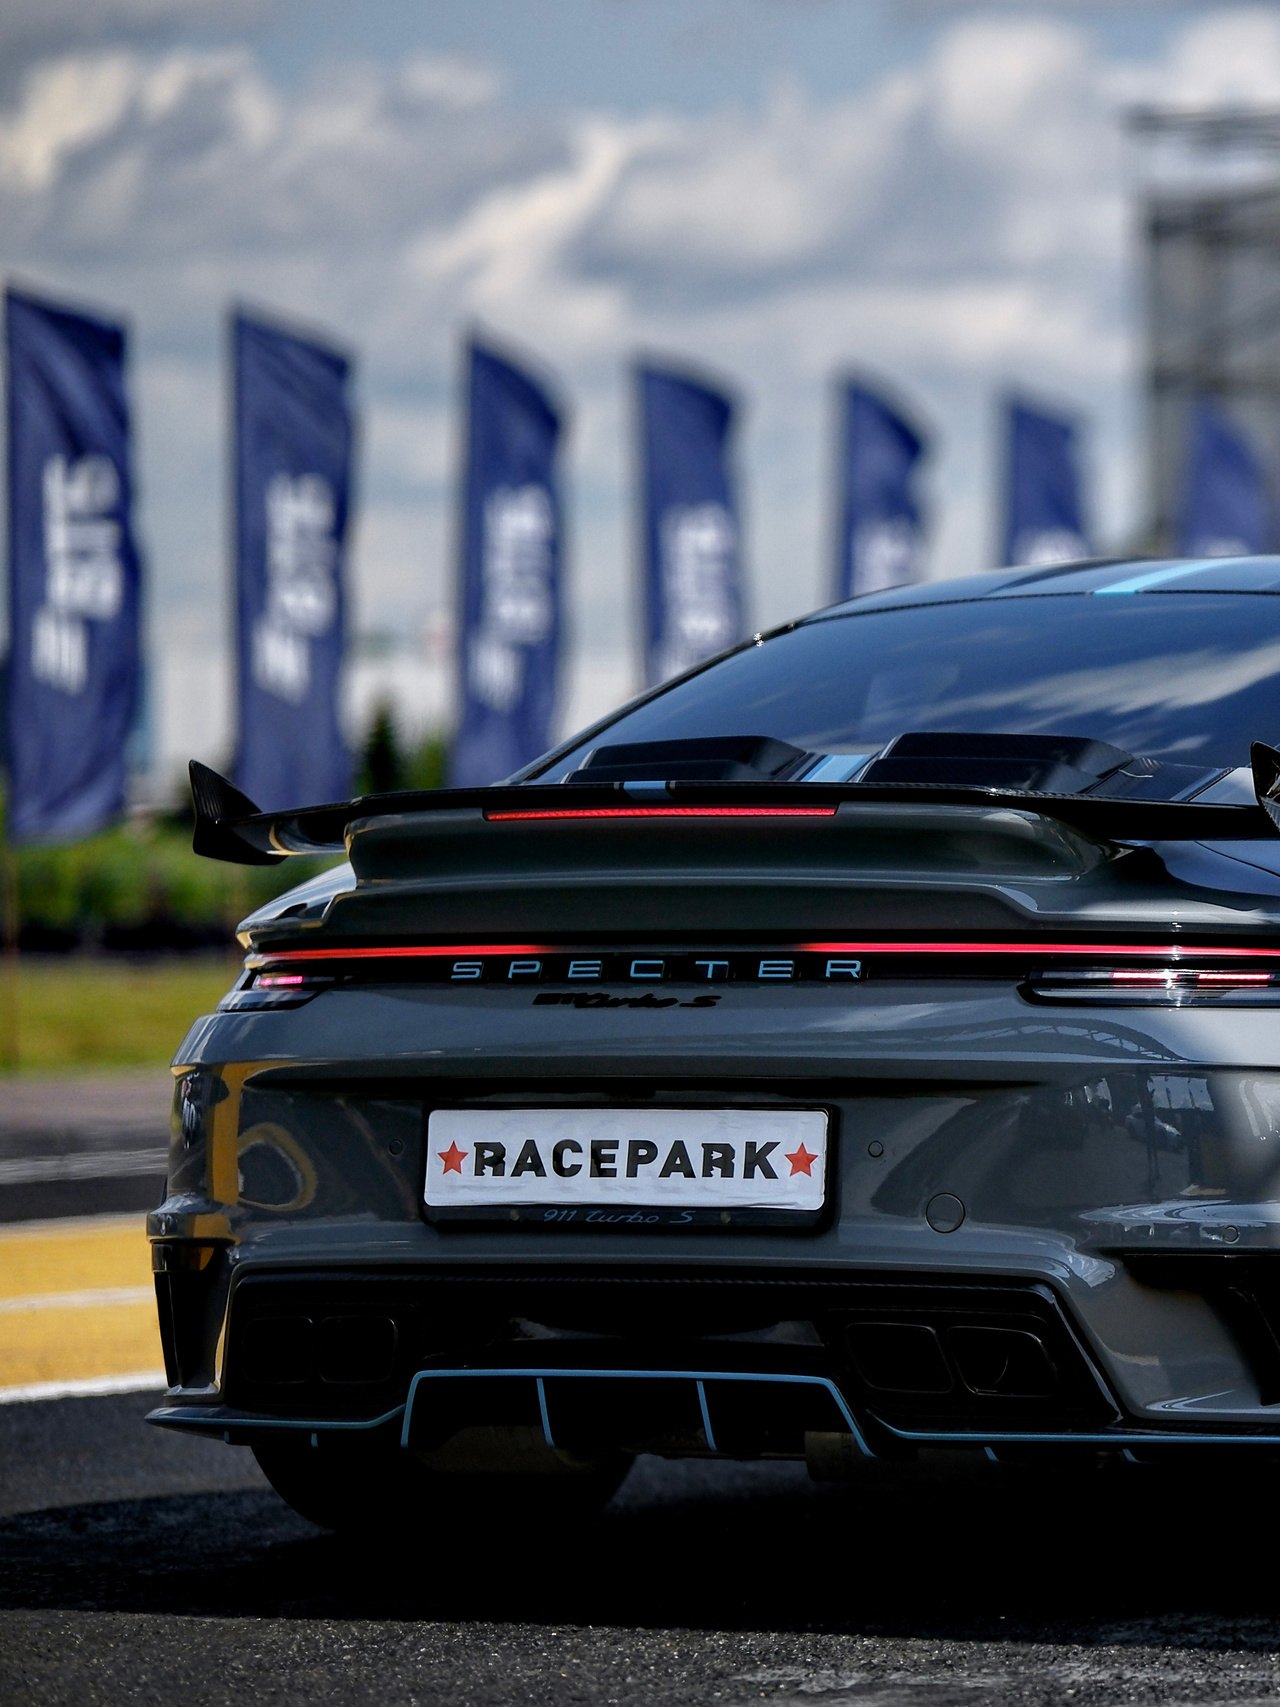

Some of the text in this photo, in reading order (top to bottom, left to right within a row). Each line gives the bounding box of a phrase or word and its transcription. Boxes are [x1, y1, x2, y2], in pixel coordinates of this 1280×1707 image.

[451, 959, 863, 980] SPECTER
[679, 995, 723, 1008] S
[473, 1138, 781, 1180] RACEPARK
[543, 1209, 577, 1222] 911
[668, 1210, 697, 1224] S
